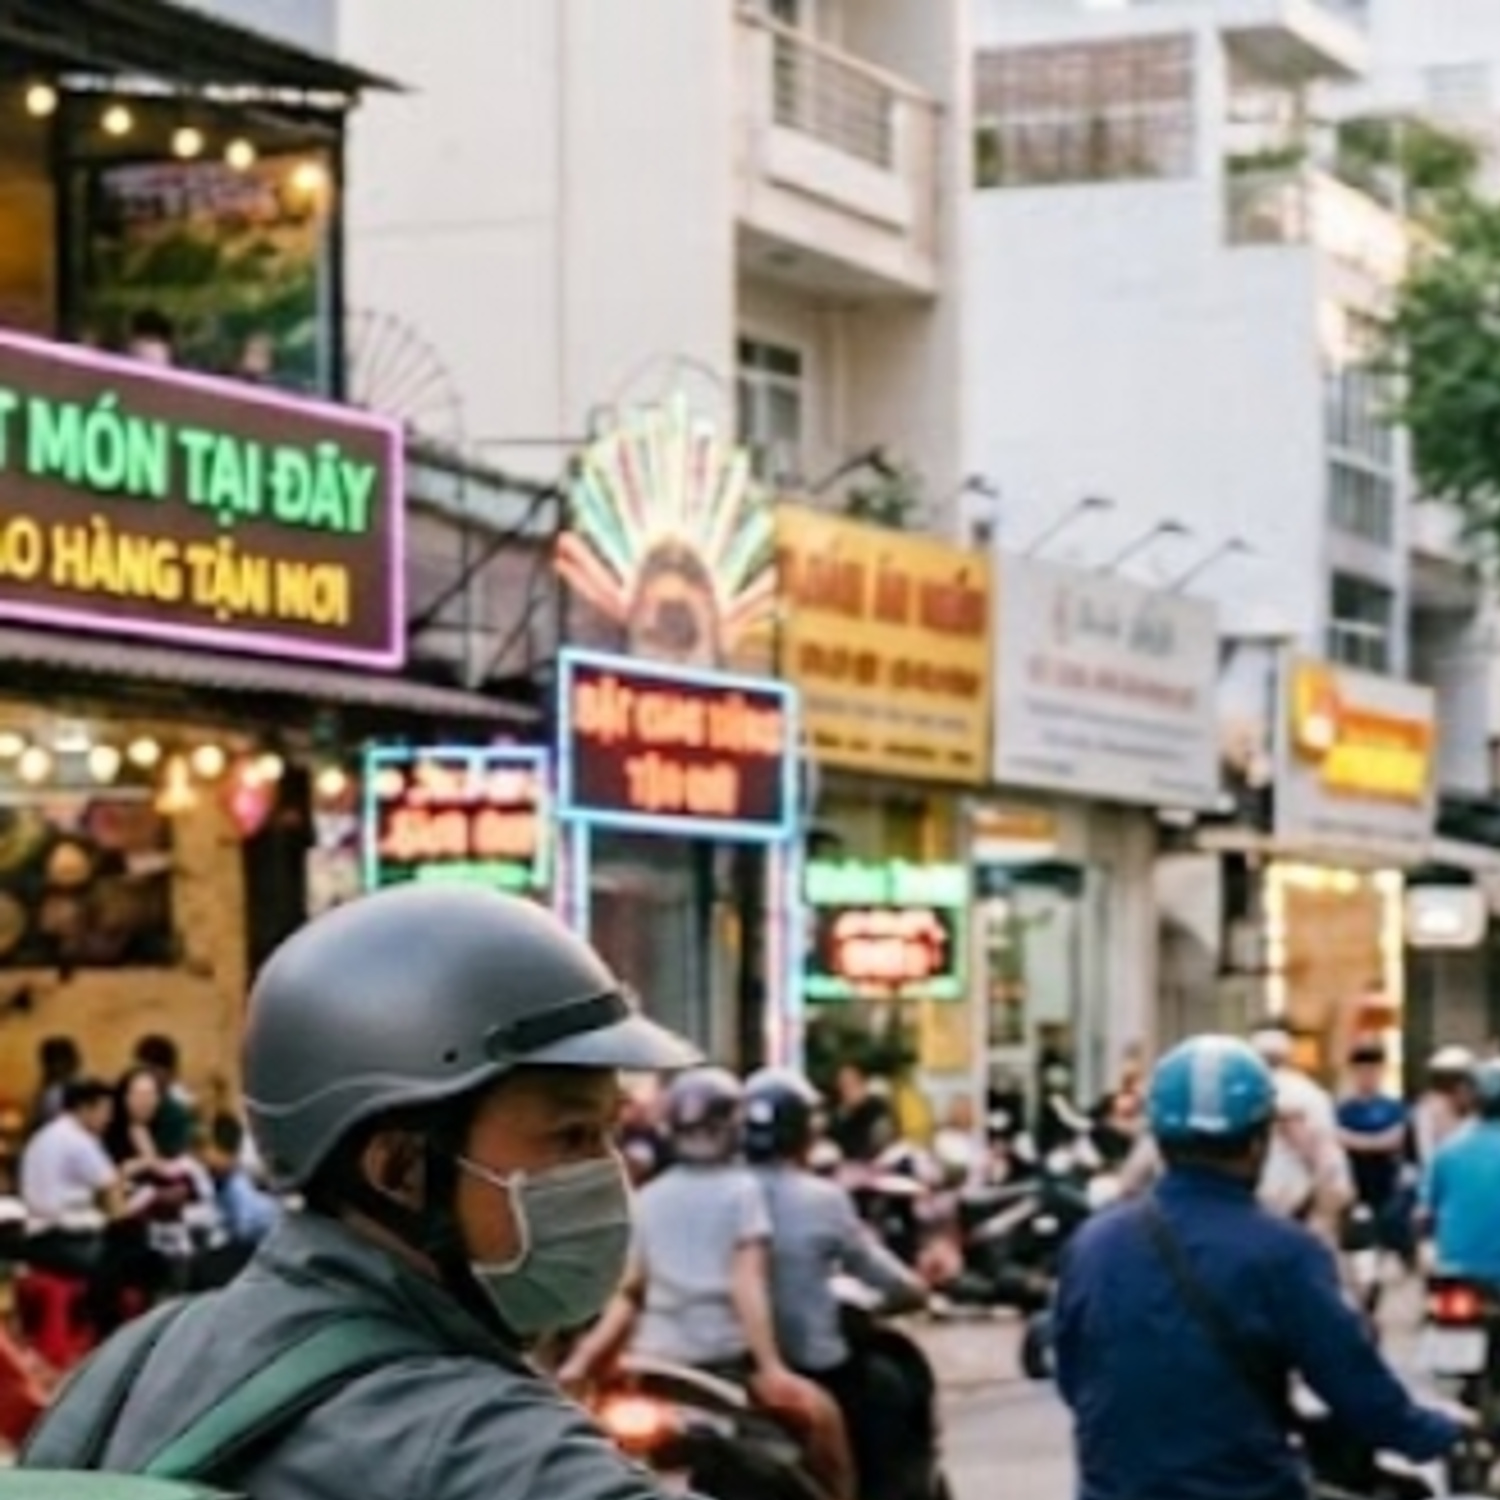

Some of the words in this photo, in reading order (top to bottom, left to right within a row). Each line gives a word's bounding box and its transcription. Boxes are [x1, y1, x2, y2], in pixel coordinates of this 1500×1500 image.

[28, 390, 168, 498] MÓN
[178, 428, 262, 527] TẠI
[270, 441, 376, 533] ĐÂY
[0, 515, 43, 580] O
[51, 512, 183, 601] HÀNG
